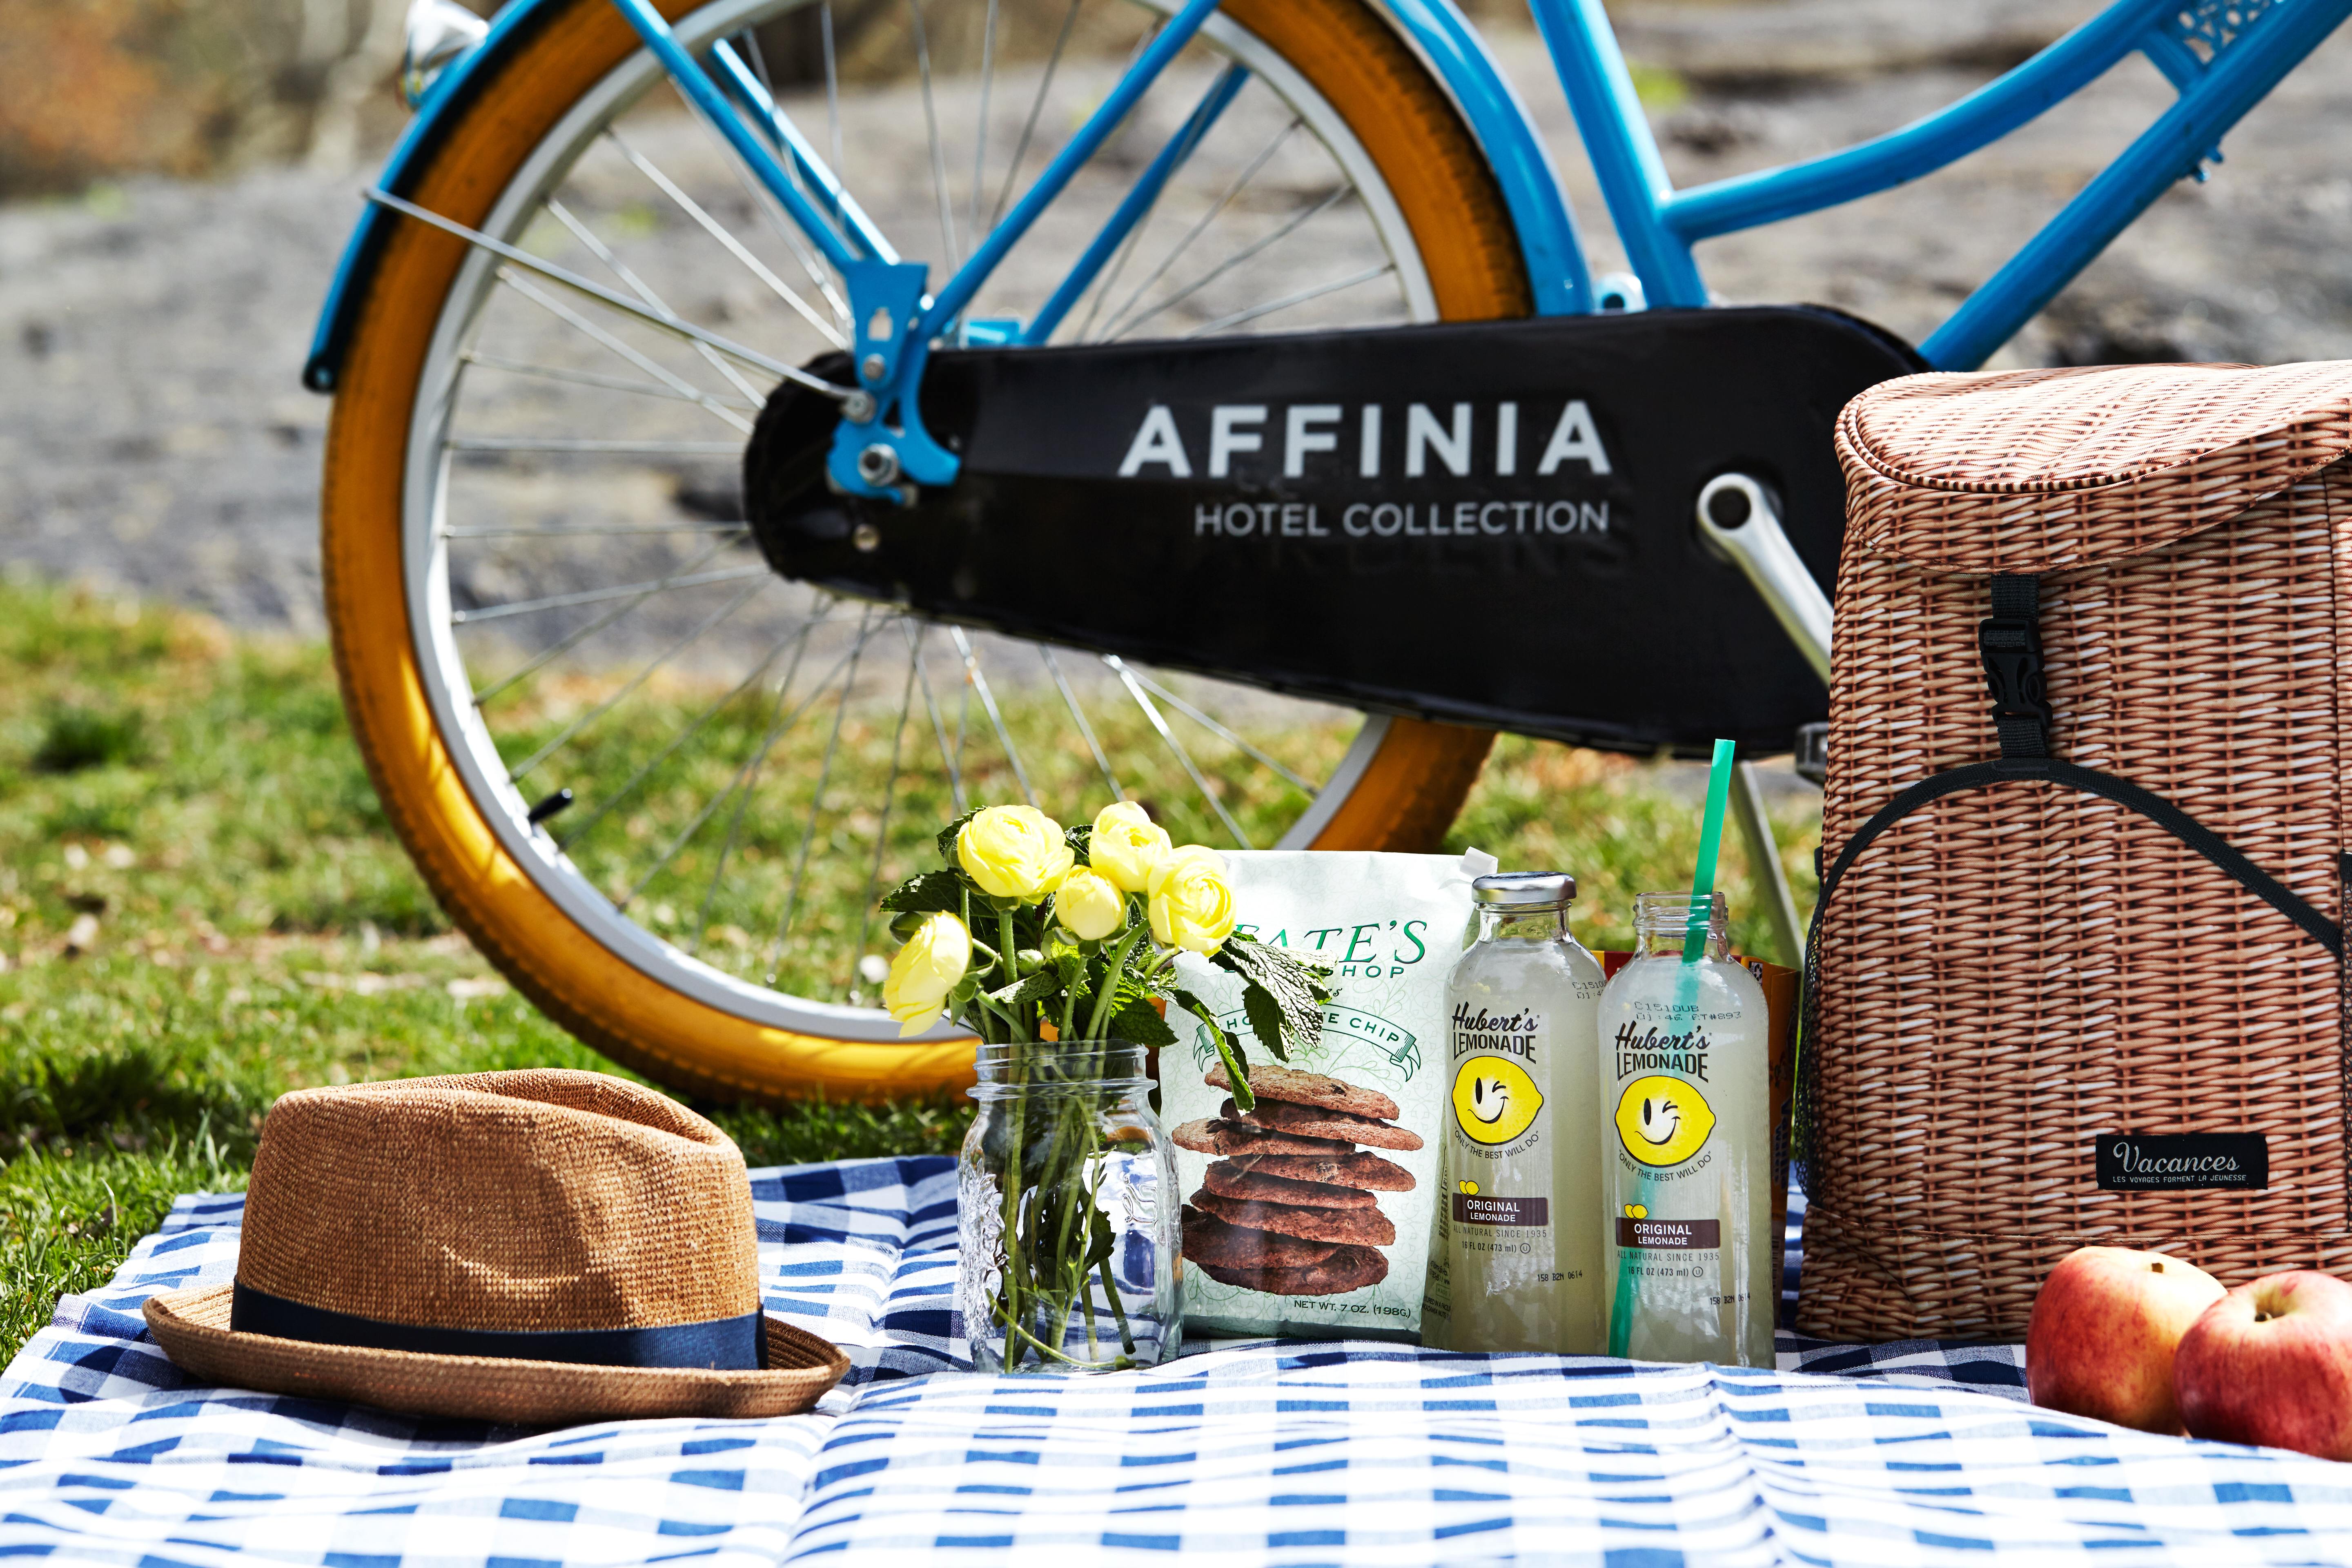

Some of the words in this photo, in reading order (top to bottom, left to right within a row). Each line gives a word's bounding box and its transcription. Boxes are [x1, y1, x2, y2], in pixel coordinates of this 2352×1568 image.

[1117, 399, 1613, 479] AFFINIA
[1194, 502, 1329, 537] HOTEL
[1342, 501, 1610, 536] COLLECTION
[1350, 1017, 1399, 1043] CHIP
[1453, 1031, 1537, 1065] LEMONADE
[1617, 1052, 1709, 1083] LEMONADE
[1470, 1145, 1483, 1158] THE
[1485, 1151, 1503, 1159] BEST
[1505, 1145, 1526, 1158] WILL
[2113, 1142, 2240, 1173] Vacances
[1637, 1168, 1652, 1180] THE
[1654, 1172, 1674, 1181] BEST
[1676, 1166, 1698, 1179] WILL
[2163, 1175, 2195, 1183] FORMENT
[1467, 1200, 1520, 1212] ORIGINAL
[1470, 1212, 1516, 1222] LEMONADE
[1453, 1225, 1461, 1234] ALL
[1463, 1226, 1492, 1237] NATURAL
[1496, 1229, 1521, 1238] SINCE
[1526, 1230, 1547, 1238] 1935
[1634, 1223, 1692, 1235] ORIGINAL
[1638, 1236, 1688, 1245] LEMONADE
[1461, 1241, 1468, 1249] 16
[1469, 1242, 1475, 1250] FL
[1477, 1243, 1486, 1251] OZ
[1488, 1243, 1502, 1252] (473
[1505, 1244, 1517, 1253] ml)
[1617, 1250, 1627, 1259] ALL
[1629, 1251, 1663, 1261] NATURAL
[1667, 1253, 1693, 1262] SINCE
[1698, 1252, 1719, 1261] 1935
[1628, 1266, 1635, 1274] 16
[1637, 1267, 1644, 1275] FL
[1646, 1267, 1655, 1276] OZ
[1657, 1267, 1674, 1277] (473
[1676, 1267, 1689, 1277] ml)
[1537, 1274, 1549, 1282] 158
[1710, 1296, 1721, 1305] 158
[1294, 1300, 1316, 1309] NET
[1319, 1302, 1336, 1311] WT.
[1351, 1305, 1369, 1314] OZ.
[1373, 1304, 1411, 1319] (198G.)
